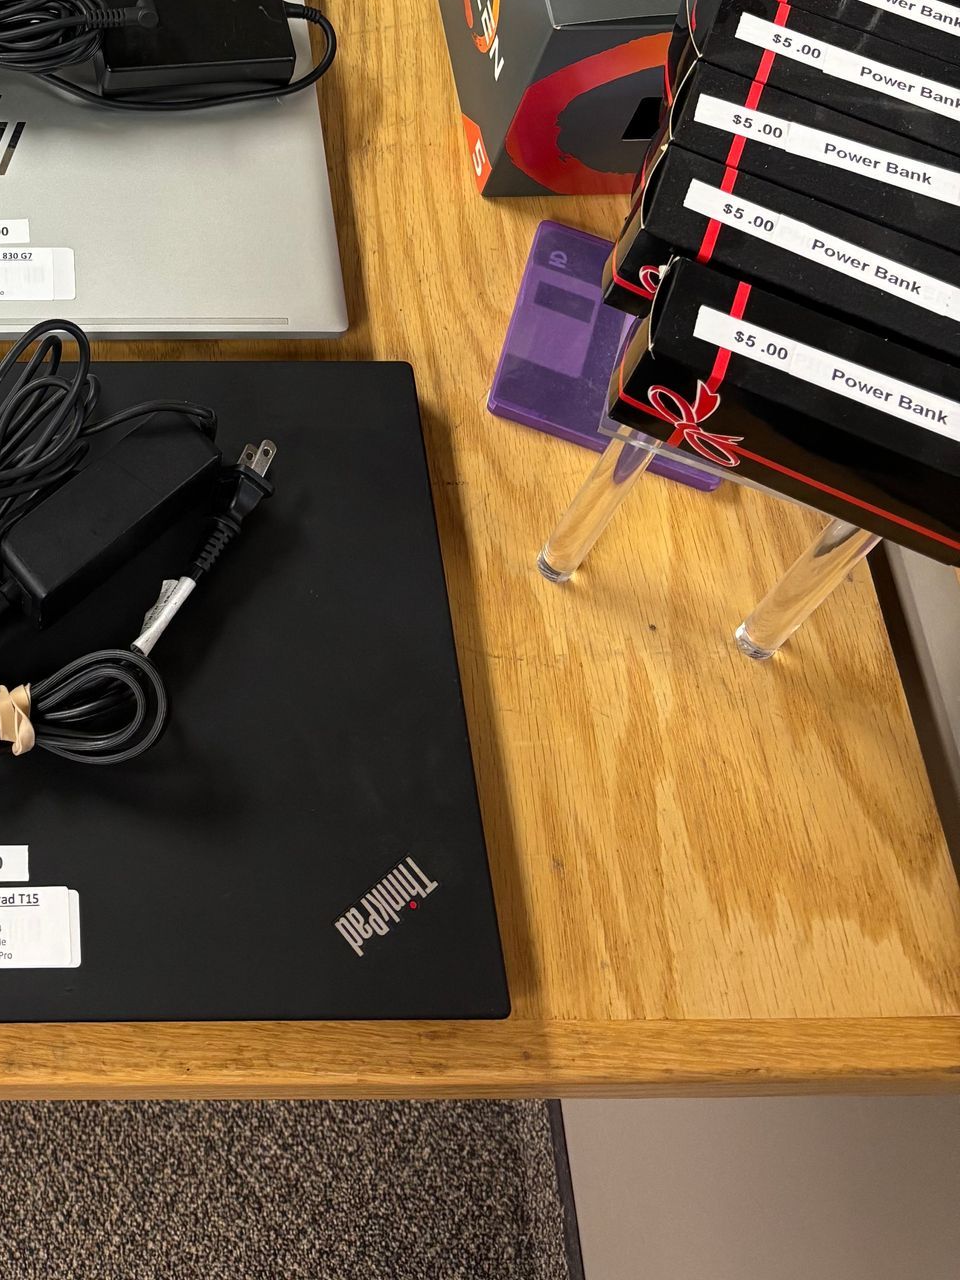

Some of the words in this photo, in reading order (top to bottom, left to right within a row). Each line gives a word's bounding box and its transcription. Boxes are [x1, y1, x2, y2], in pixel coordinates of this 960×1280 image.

[860, 66, 915, 93] Power
[472, 138, 486, 177] 5
[823, 142, 881, 169] Power
[886, 161, 933, 185] Bank
[2, 252, 18, 260] 830
[21, 252, 33, 260] G7
[810, 238, 870, 272] Power
[874, 265, 922, 296] Bank
[831, 368, 893, 403] Power
[898, 394, 949, 425] Bank
[18, 893, 39, 906] T15
[334, 856, 439, 957] ThinkPad
